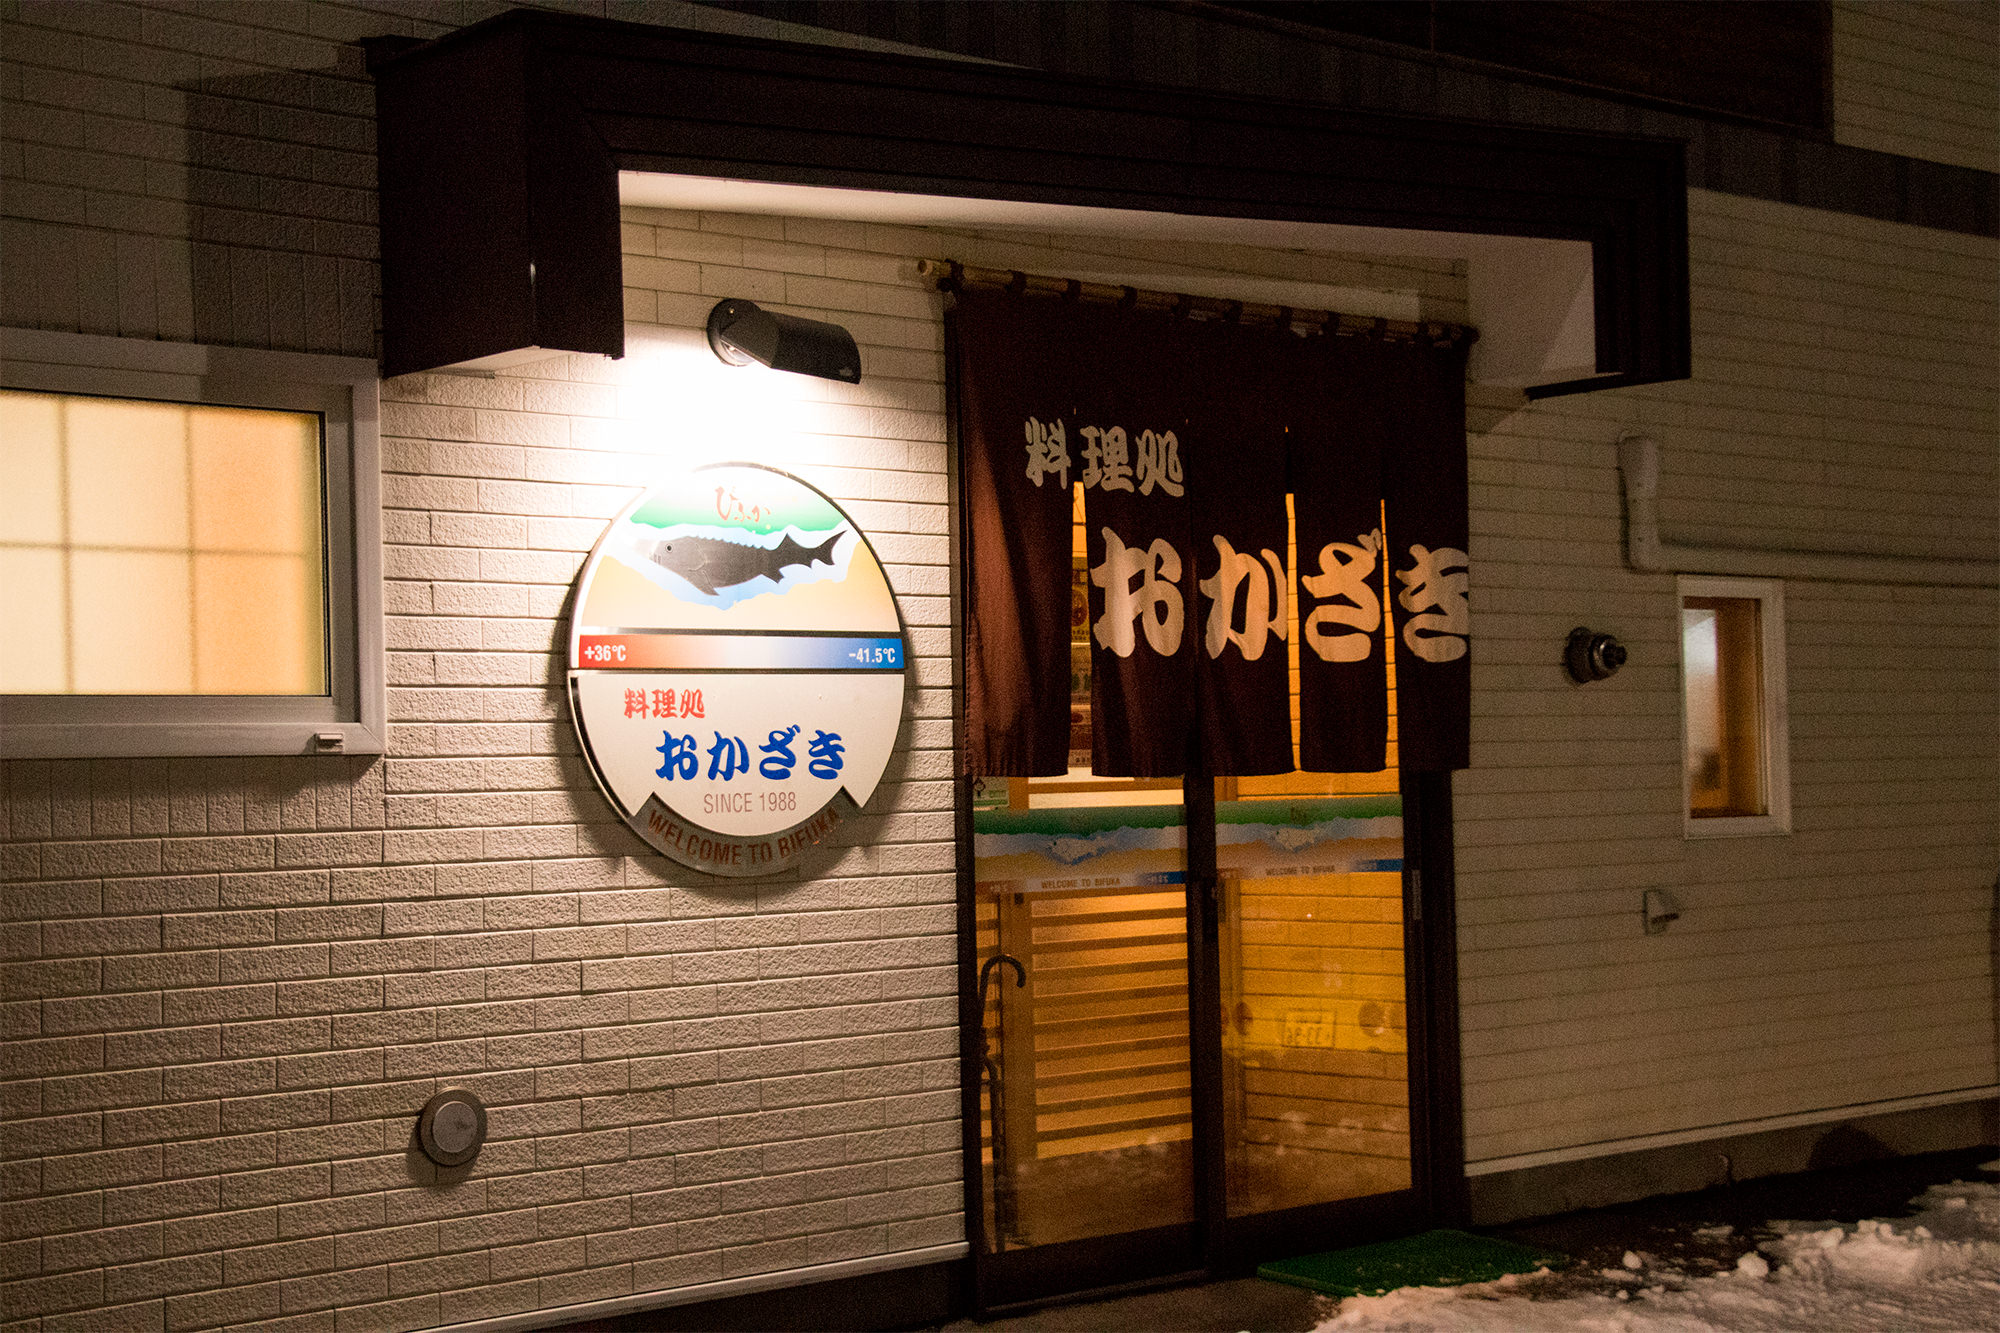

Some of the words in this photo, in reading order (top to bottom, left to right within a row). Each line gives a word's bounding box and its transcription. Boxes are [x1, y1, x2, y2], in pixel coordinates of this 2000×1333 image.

[1025, 416, 1185, 498] 料理処
[1090, 526, 1470, 663] おかざき
[623, 687, 706, 720] 料理処
[655, 724, 847, 782] おかざき
[703, 792, 753, 814] SINCE
[759, 791, 797, 812] 1988
[648, 809, 743, 866] WELCOME
[750, 842, 772, 865] TO
[777, 806, 840, 859] BIFUKA
[1041, 879, 1078, 889] WELCOME
[1081, 878, 1091, 888] TO
